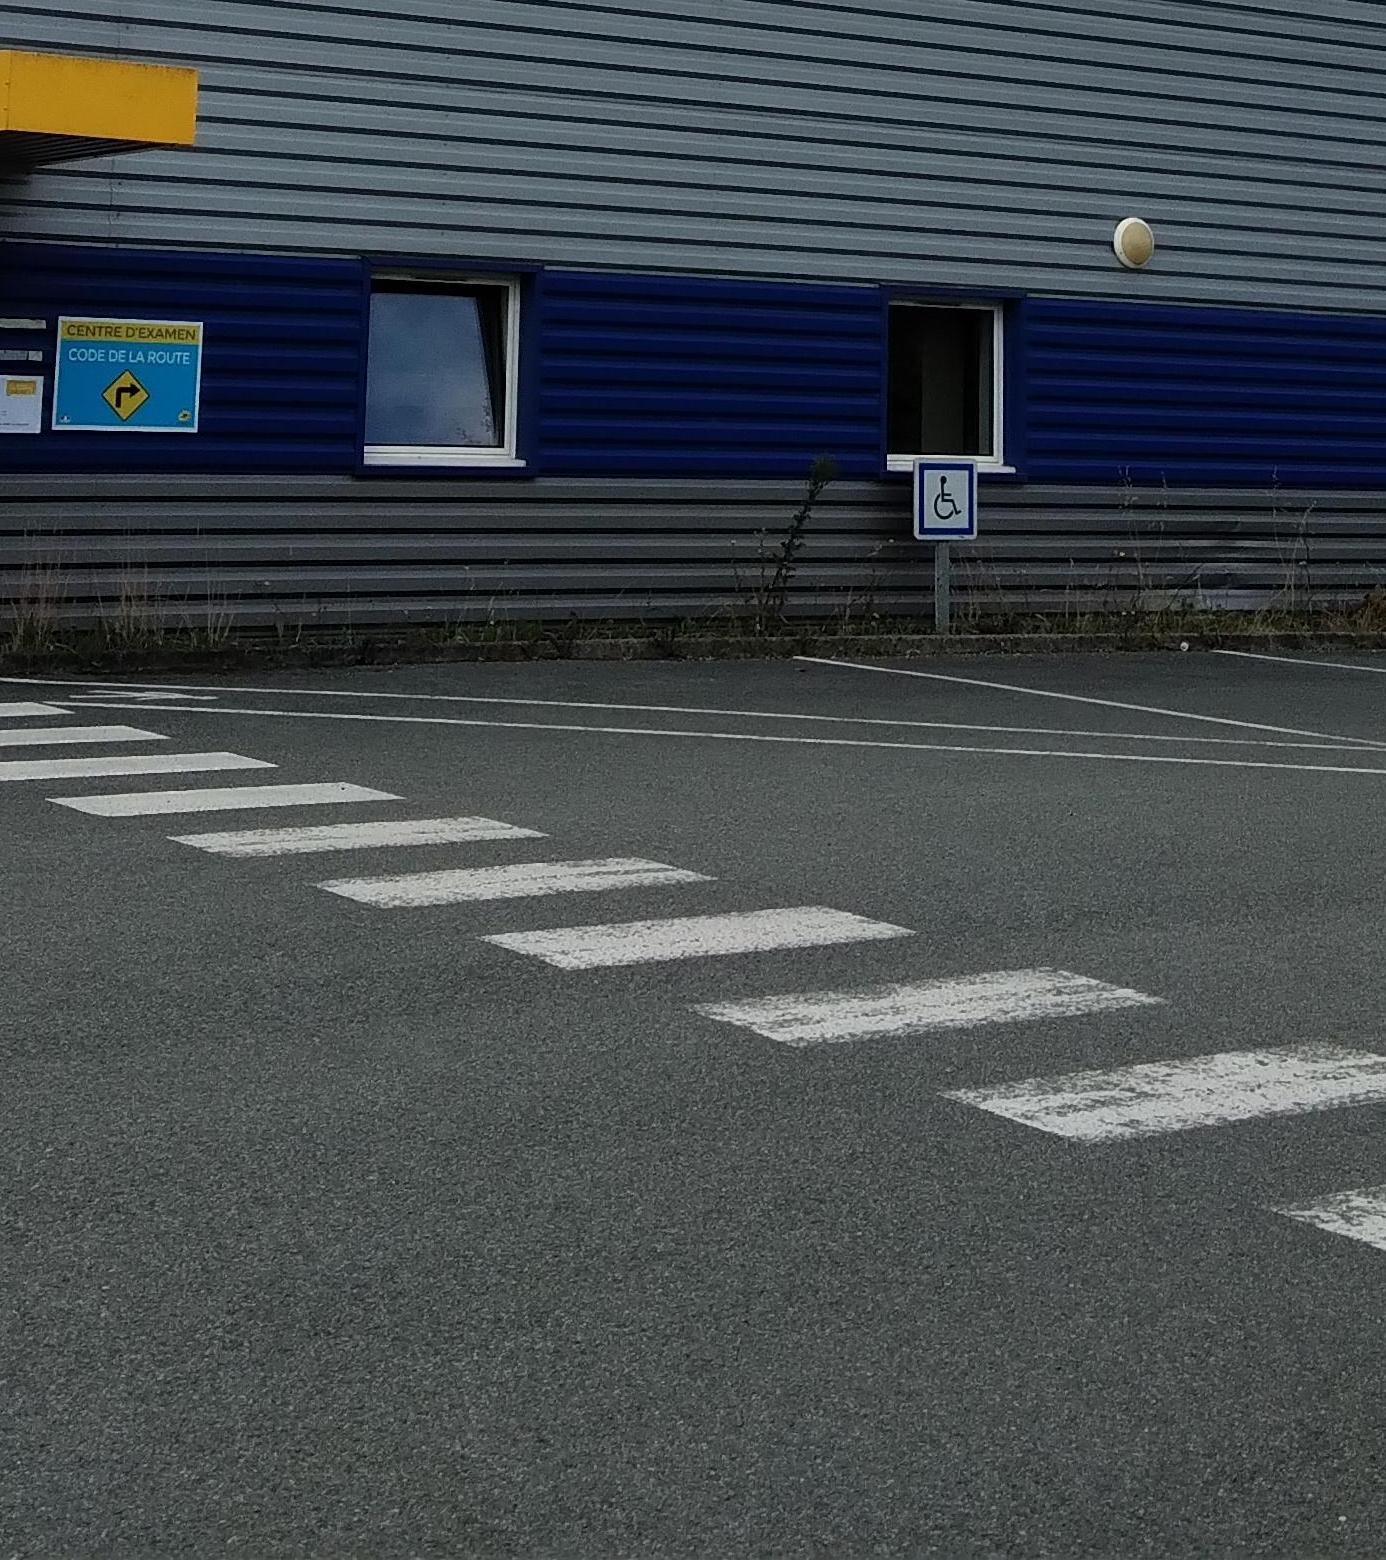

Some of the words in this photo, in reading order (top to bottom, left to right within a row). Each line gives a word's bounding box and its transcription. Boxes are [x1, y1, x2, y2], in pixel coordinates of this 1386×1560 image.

[67, 324, 123, 338] CENTRE
[126, 326, 197, 341] D'EXAMEN
[68, 348, 106, 362] CODE
[108, 349, 127, 363] DE
[129, 350, 146, 364] LA
[148, 351, 191, 365] ROUTE
